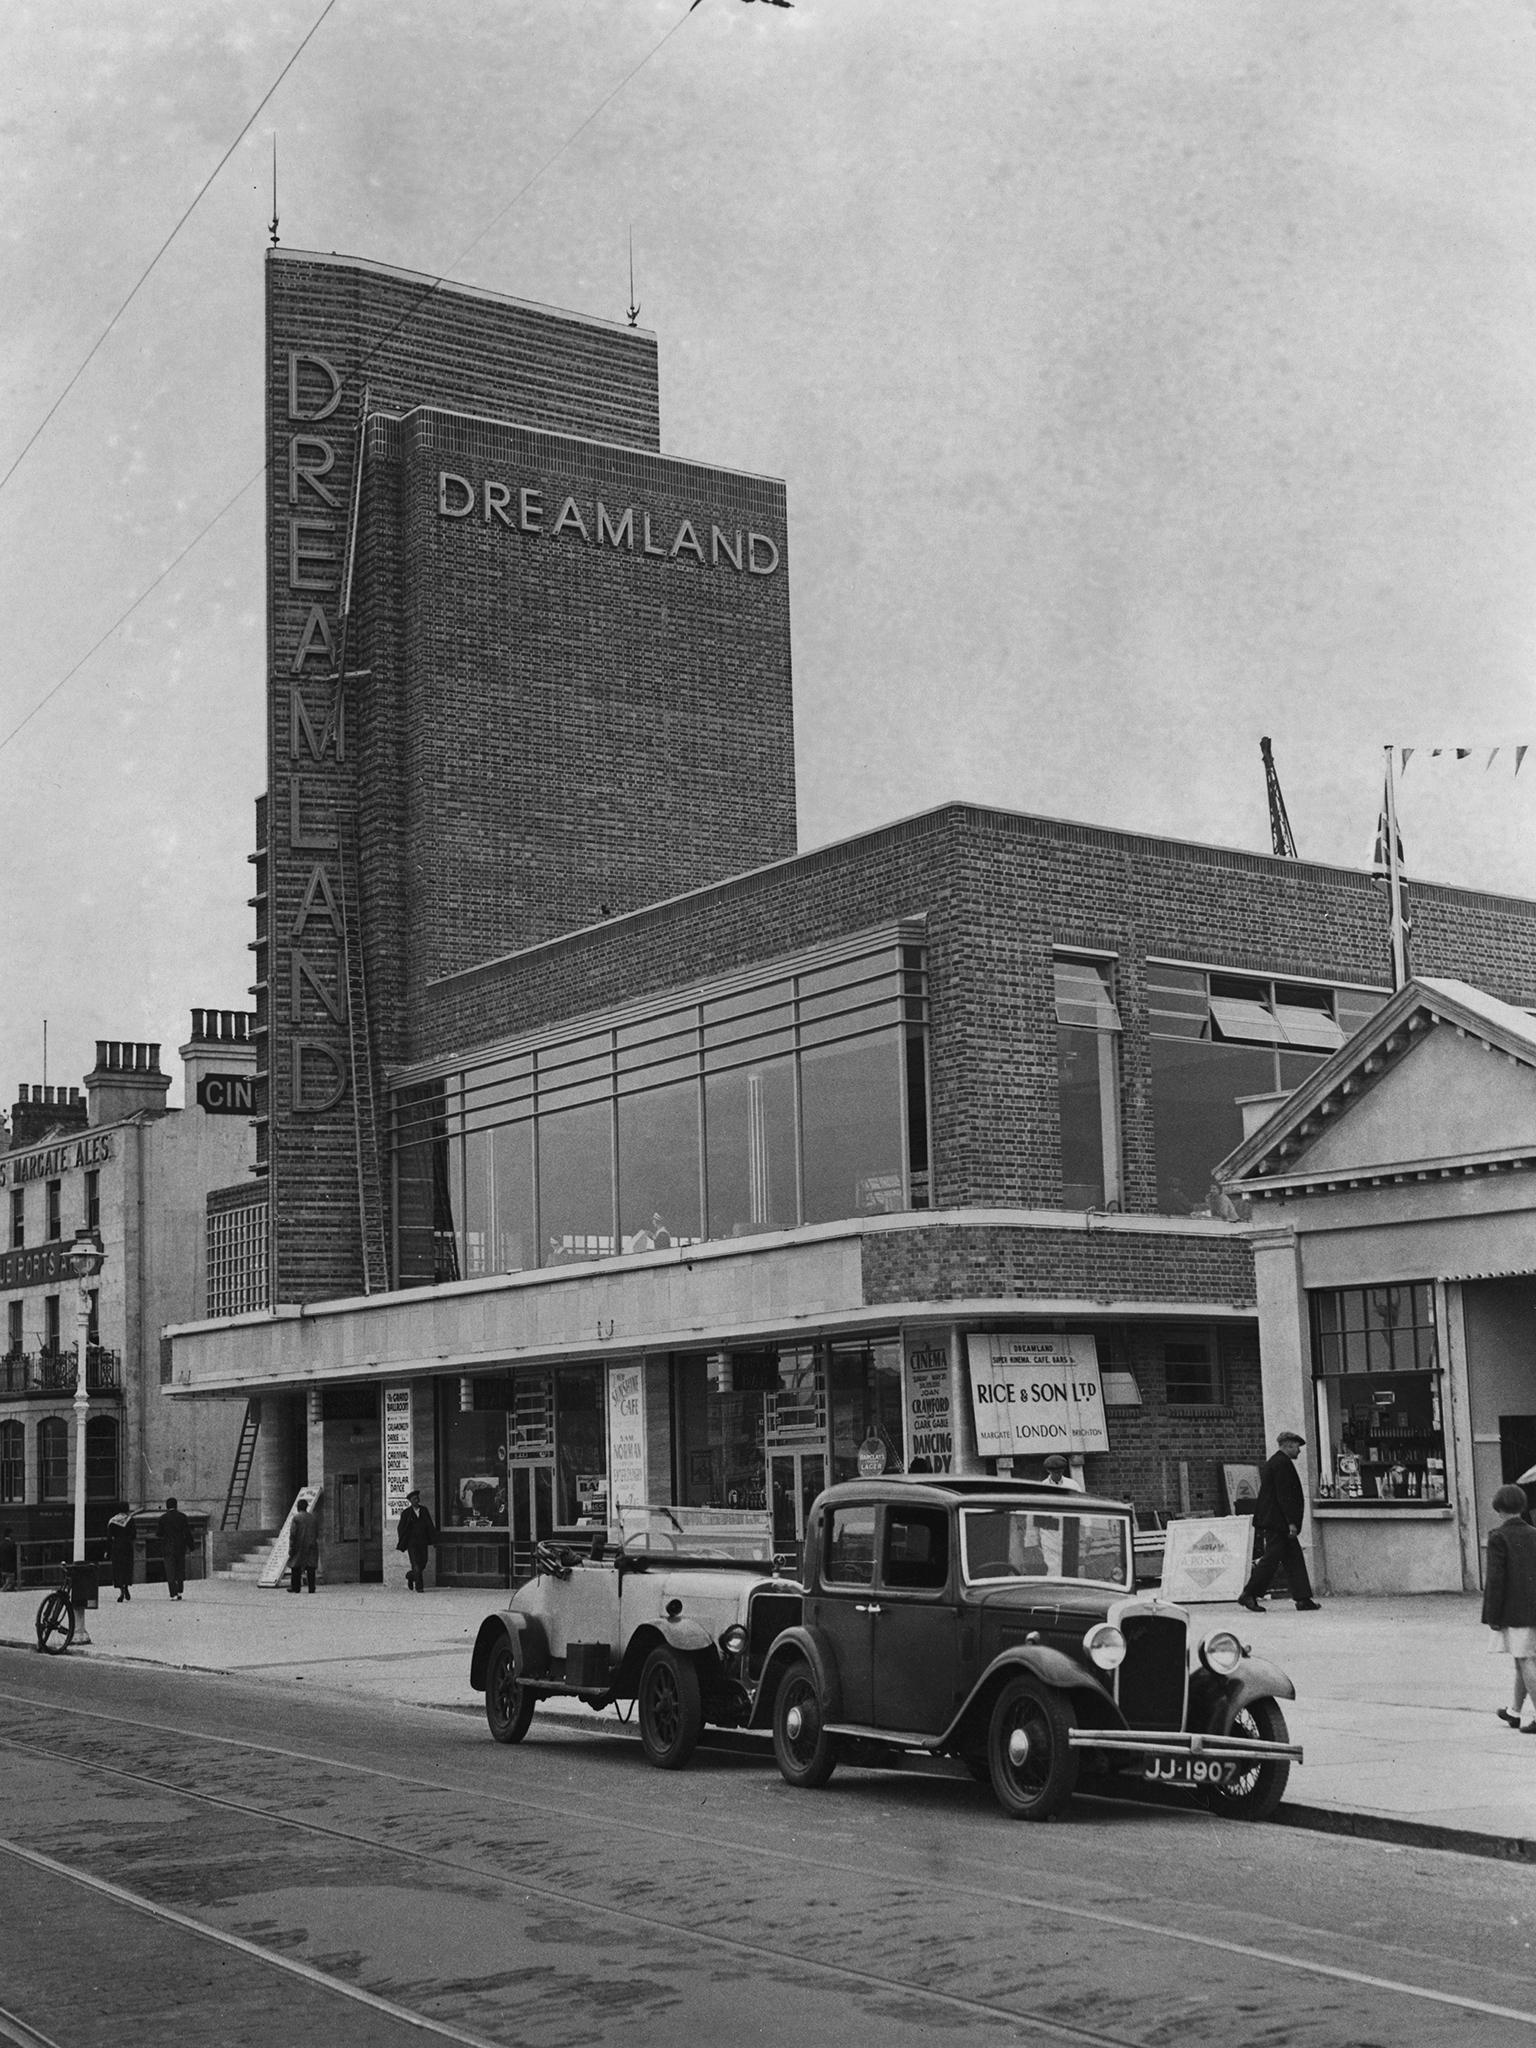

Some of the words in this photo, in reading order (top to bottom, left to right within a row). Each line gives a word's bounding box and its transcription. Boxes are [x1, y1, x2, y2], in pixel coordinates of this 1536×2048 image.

[436, 470, 782, 577] DREAMLAND
[286, 351, 348, 1115] DREAMLAND
[75, 1135, 111, 1168] ALES
[17, 1251, 56, 1281] PORTS
[1013, 1344, 1054, 1353] DREAMLAND
[910, 1351, 948, 1370] CINEMA
[992, 1356, 1008, 1364] SUPER
[920, 1388, 940, 1397] JOAN
[977, 1383, 1015, 1404] RICE
[1020, 1388, 1029, 1403] &
[1031, 1383, 1067, 1402] SON
[620, 1398, 639, 1417] CAFE
[912, 1397, 950, 1414] CRAWFORD
[914, 1419, 932, 1430] CLARK
[932, 1418, 949, 1428] GABLE
[1015, 1424, 1067, 1438] LONDON
[1072, 1428, 1102, 1437] BRIGHTON
[912, 1432, 952, 1455] DANCING
[981, 1431, 1011, 1440] MARGATE
[913, 1455, 952, 1473] ADY
[387, 1476, 409, 1484] POPULAR
